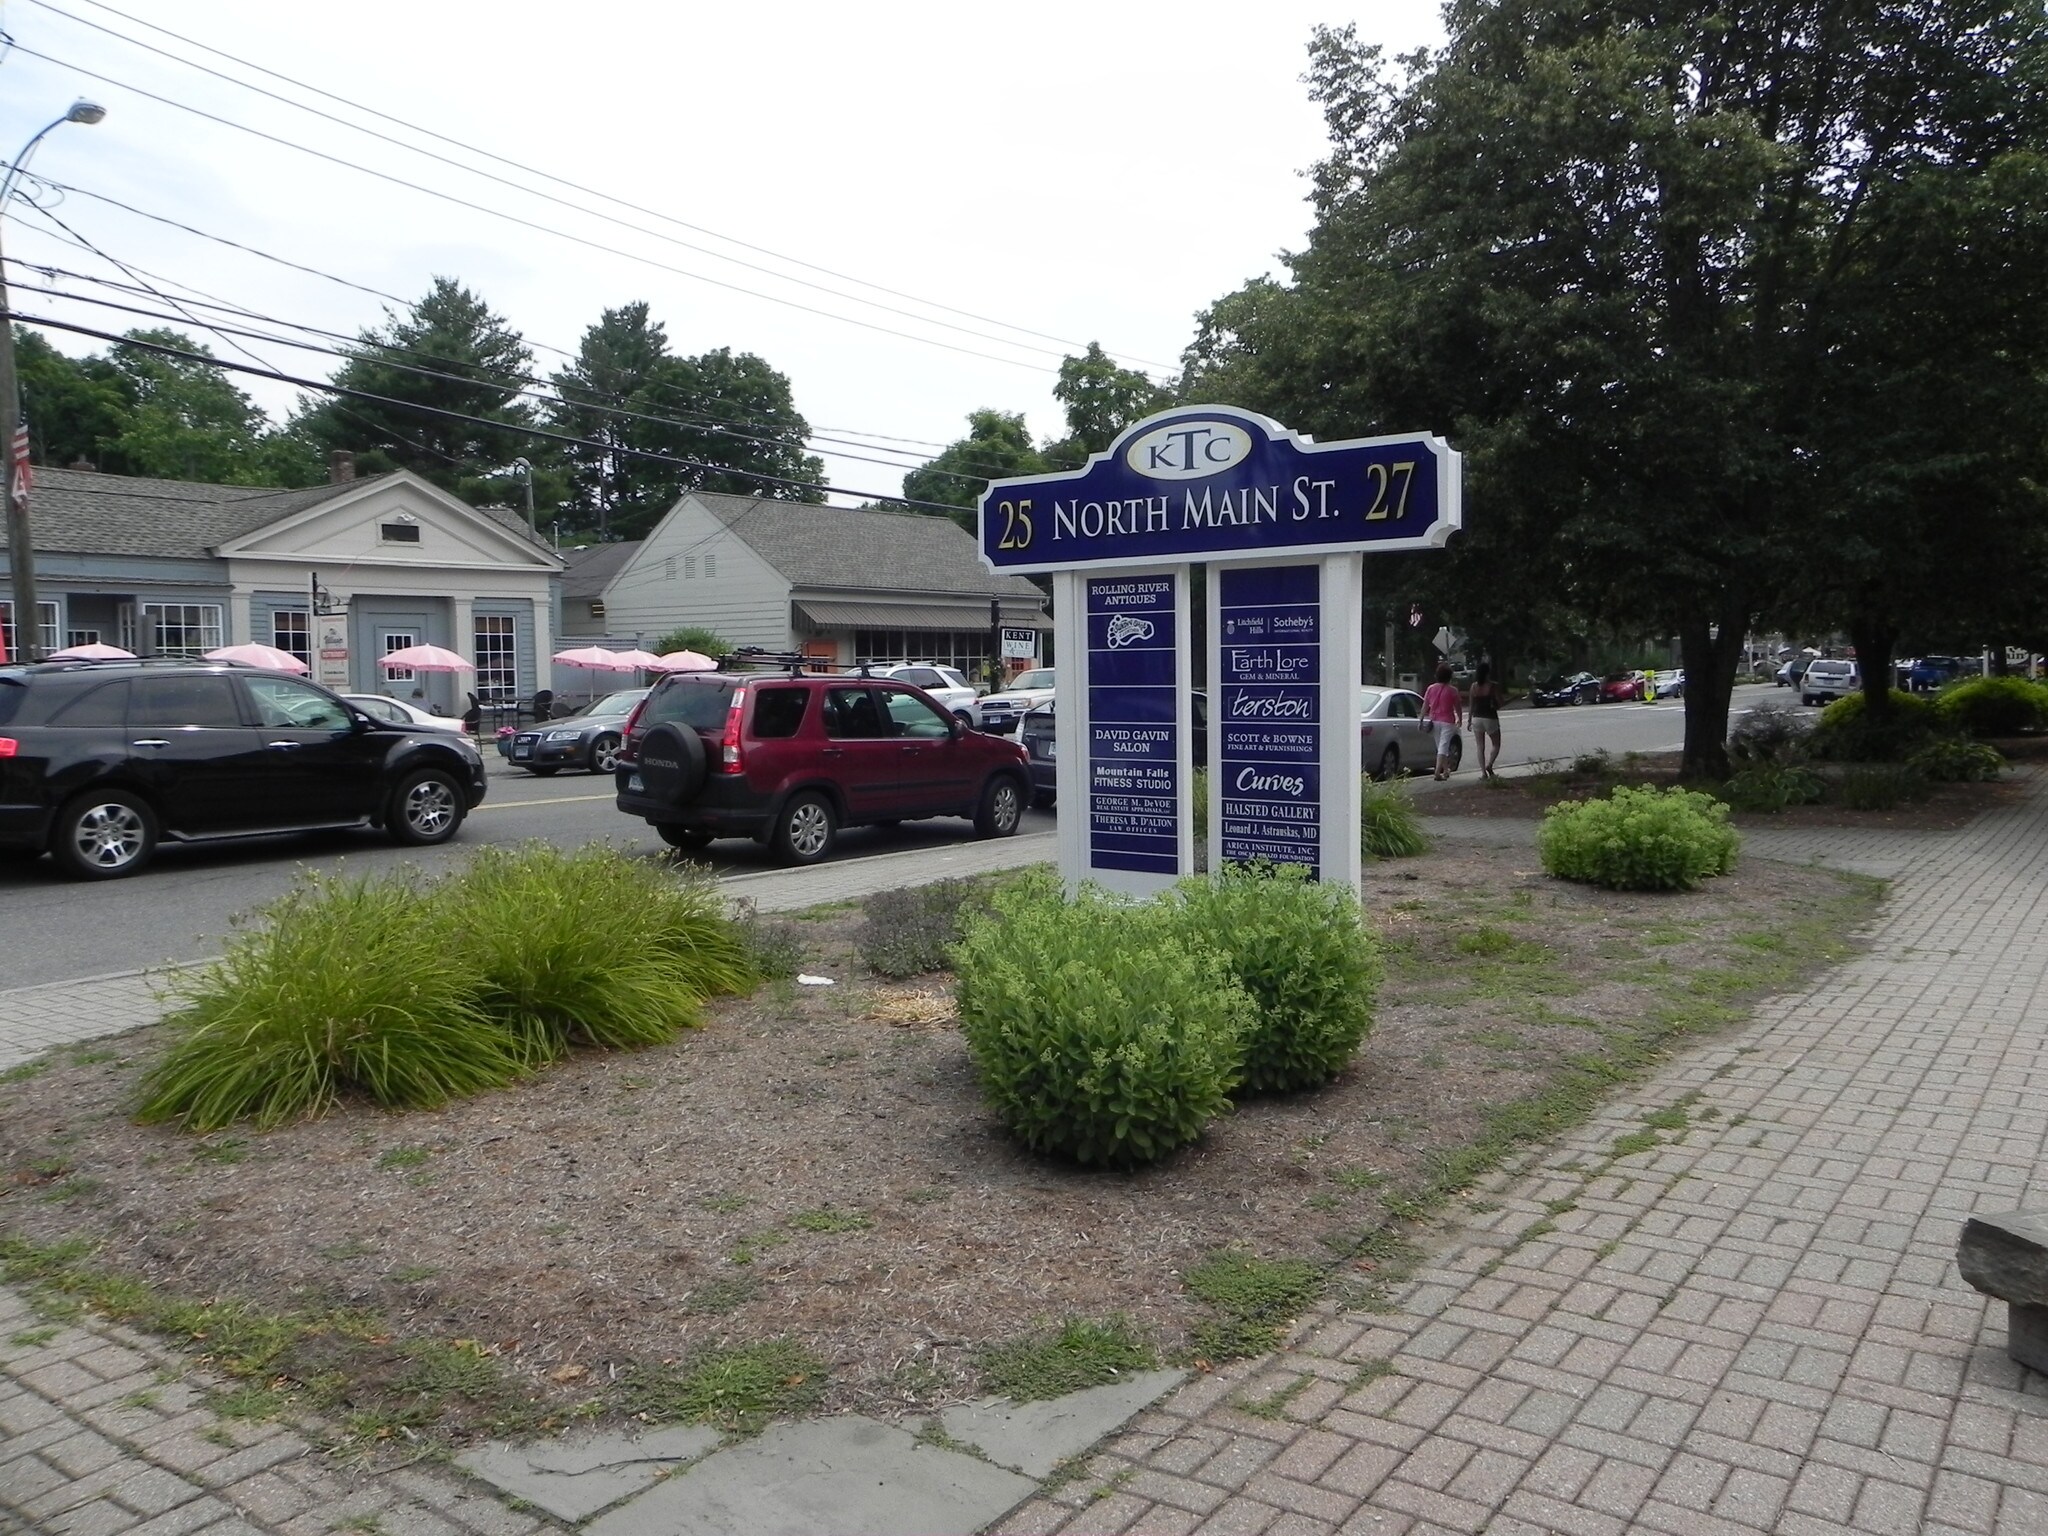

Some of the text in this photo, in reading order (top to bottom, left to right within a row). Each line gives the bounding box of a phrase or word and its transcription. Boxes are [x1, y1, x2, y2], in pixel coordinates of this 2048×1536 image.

[1150, 428, 1231, 472] KTC
[998, 461, 1415, 550] 25 NORTH MAIN ST. 27
[1092, 582, 1170, 595] ROLLING RIVER
[1104, 594, 1157, 605] ANTIQUES
[1274, 616, 1314, 629] Sotheby's
[1005, 631, 1032, 640] KENT
[1006, 641, 1031, 650] WINE
[1231, 649, 1309, 672] Earth Lore
[1095, 730, 1169, 741] DAVID GAVIN
[1227, 733, 1312, 744] SCOTT & BOWNE
[1113, 742, 1150, 752] SALON
[644, 757, 679, 769] HONDA
[1096, 766, 1169, 778] Mountain Falls
[1094, 777, 1172, 790] FITNESS STUDIO
[1236, 766, 1304, 796] Curves
[1096, 797, 1129, 806] GEORGE
[1226, 803, 1315, 820] HALSTED GALLERY
[1095, 814, 1128, 825] THERESA
[1225, 822, 1251, 835] Leonard
[1302, 826, 1317, 839] MD
[1226, 842, 1250, 850] ARICA
[1298, 847, 1315, 855] INC.
[1279, 853, 1315, 862] FOUNDATION
